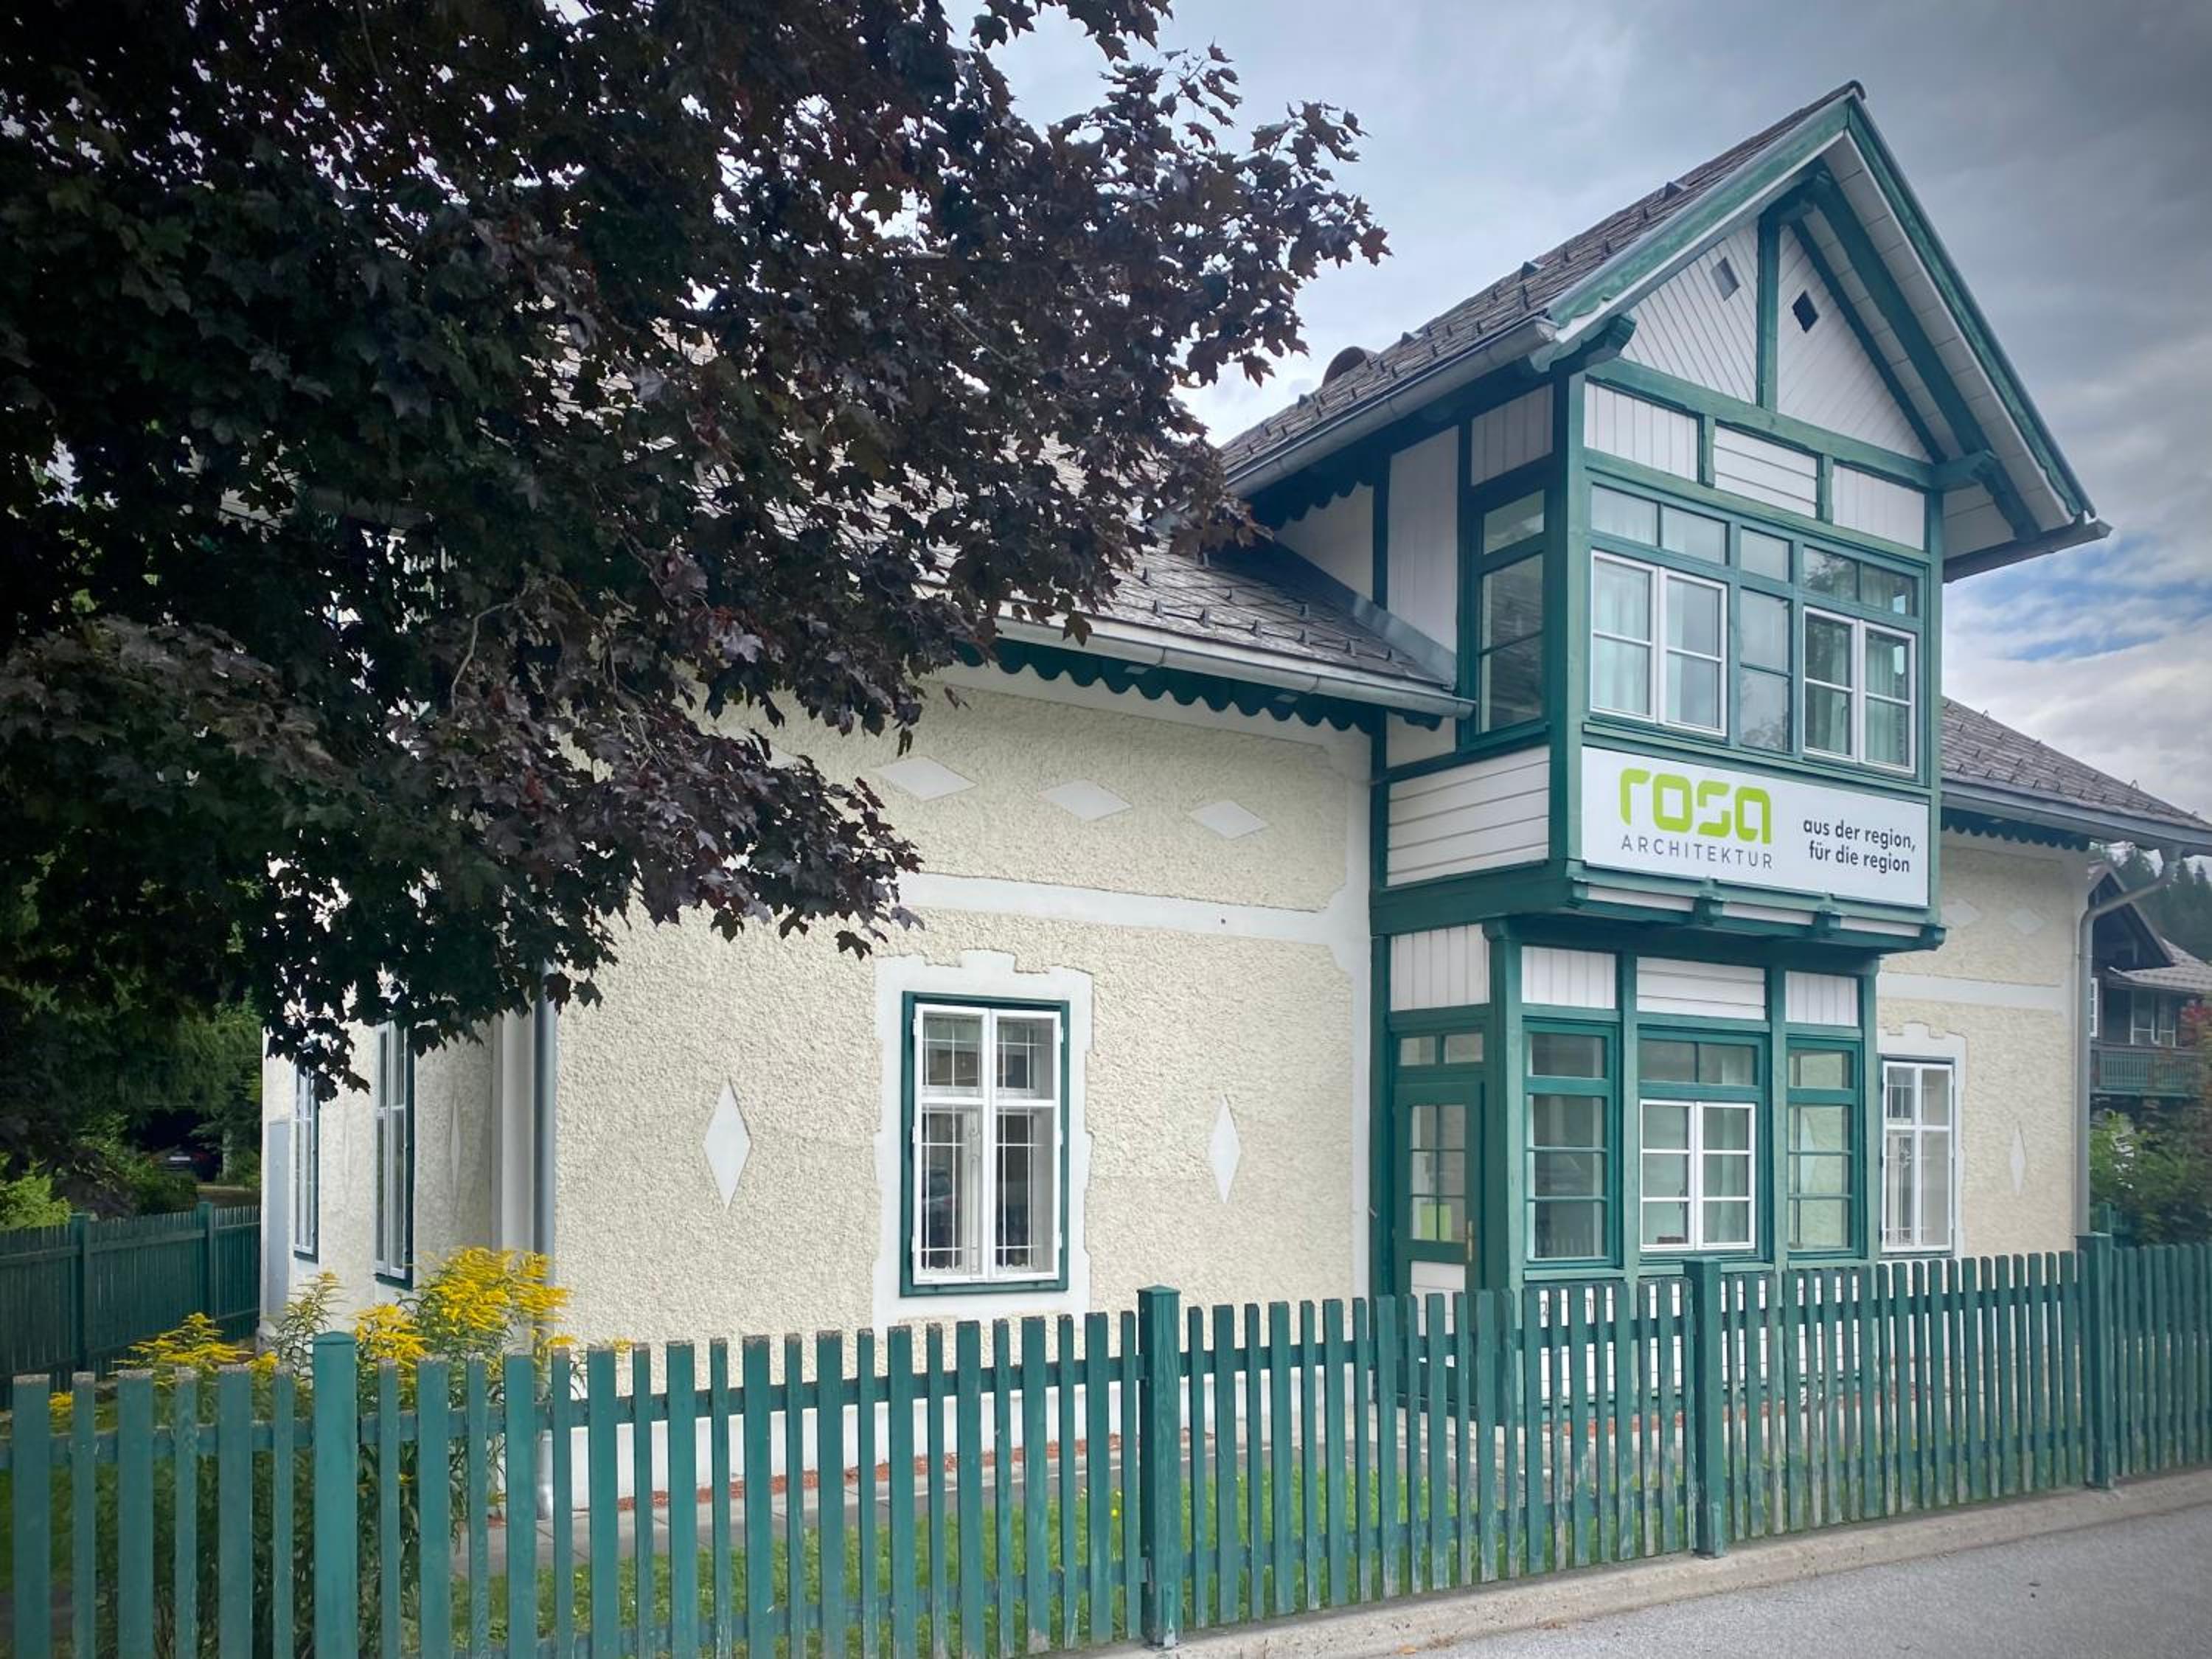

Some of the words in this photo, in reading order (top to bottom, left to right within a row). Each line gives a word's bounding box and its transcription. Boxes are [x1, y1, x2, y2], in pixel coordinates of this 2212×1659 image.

[1620, 768, 1772, 844] rosa
[1621, 835, 1773, 869] ARCHITEKTUR
[1804, 819, 1830, 836] aus
[1834, 818, 1860, 840] der
[1864, 828, 1916, 852] region,
[1809, 840, 1831, 861] für
[1835, 844, 1859, 865] die
[1863, 852, 1910, 874] region
